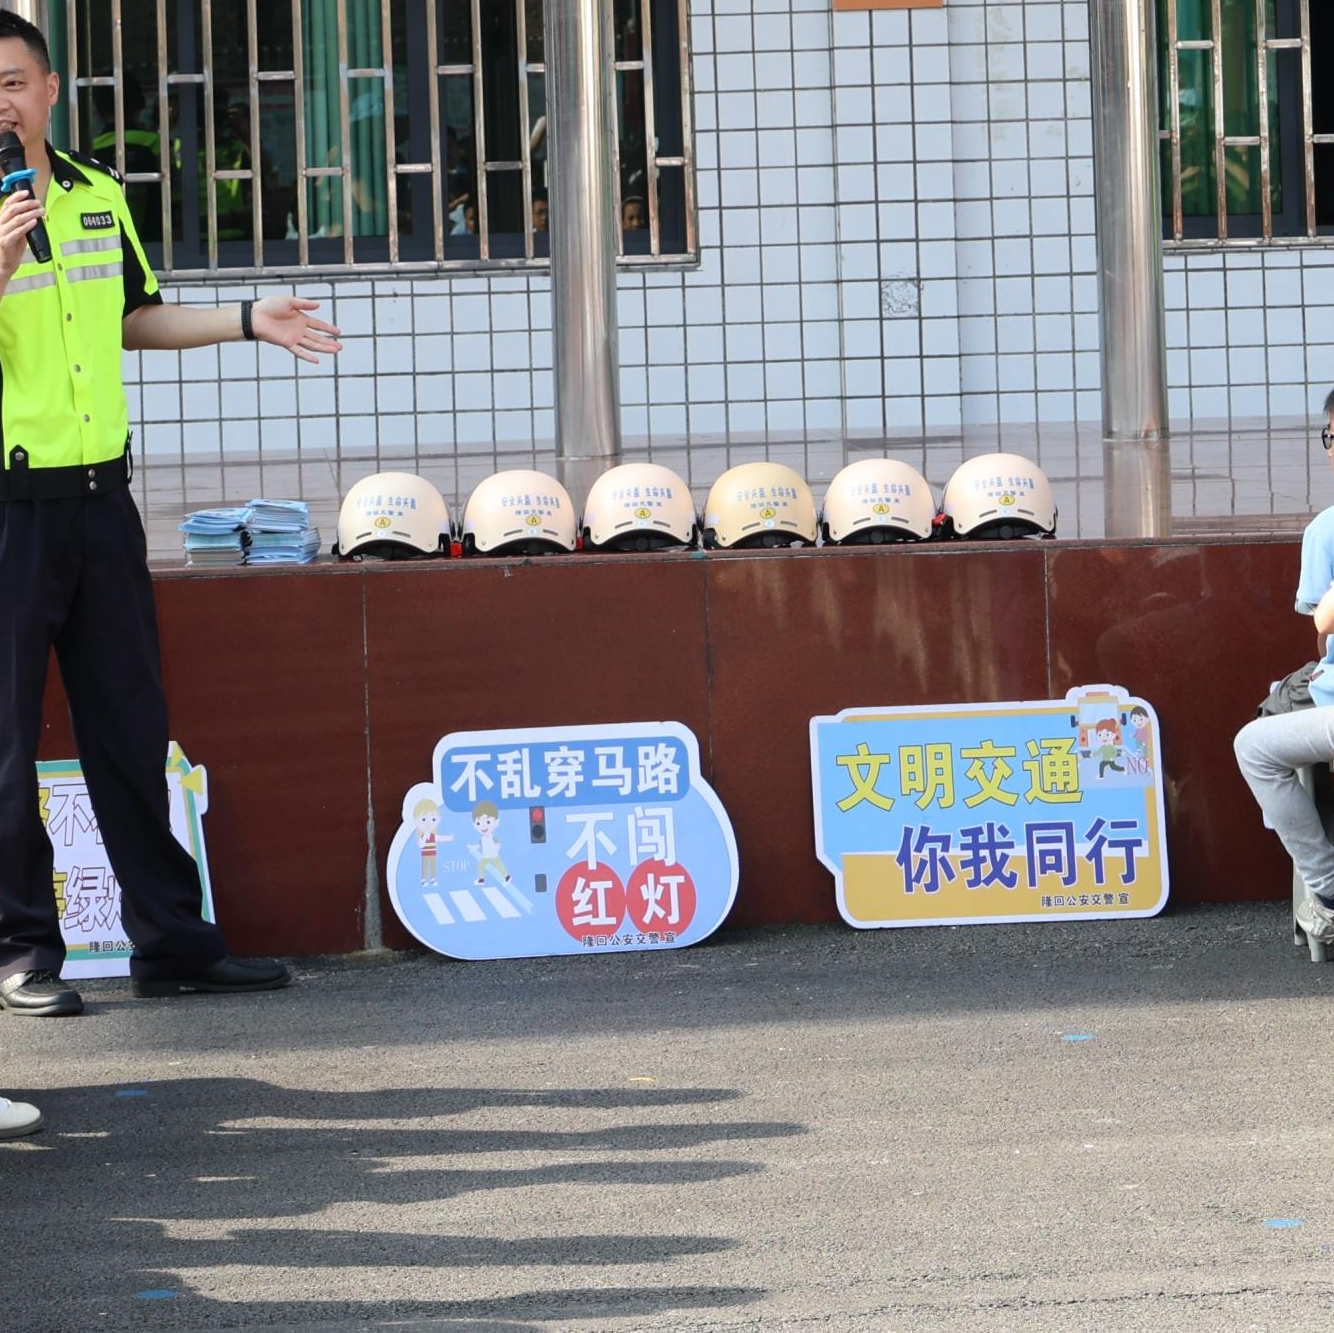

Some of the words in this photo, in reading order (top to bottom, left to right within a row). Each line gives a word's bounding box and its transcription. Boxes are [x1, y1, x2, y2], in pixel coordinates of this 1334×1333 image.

[450, 741, 682, 803] 不乱穿马路
[835, 736, 1084, 812] 文明交通
[565, 805, 678, 871] 不闯
[894, 816, 1144, 895] 你我同行
[571, 872, 686, 927] 红灯
[1041, 894, 1115, 908] 隆回公安交警
[1117, 892, 1130, 906] 宣
[582, 933, 660, 948] 隆回公安交警
[664, 931, 677, 944] 宣
